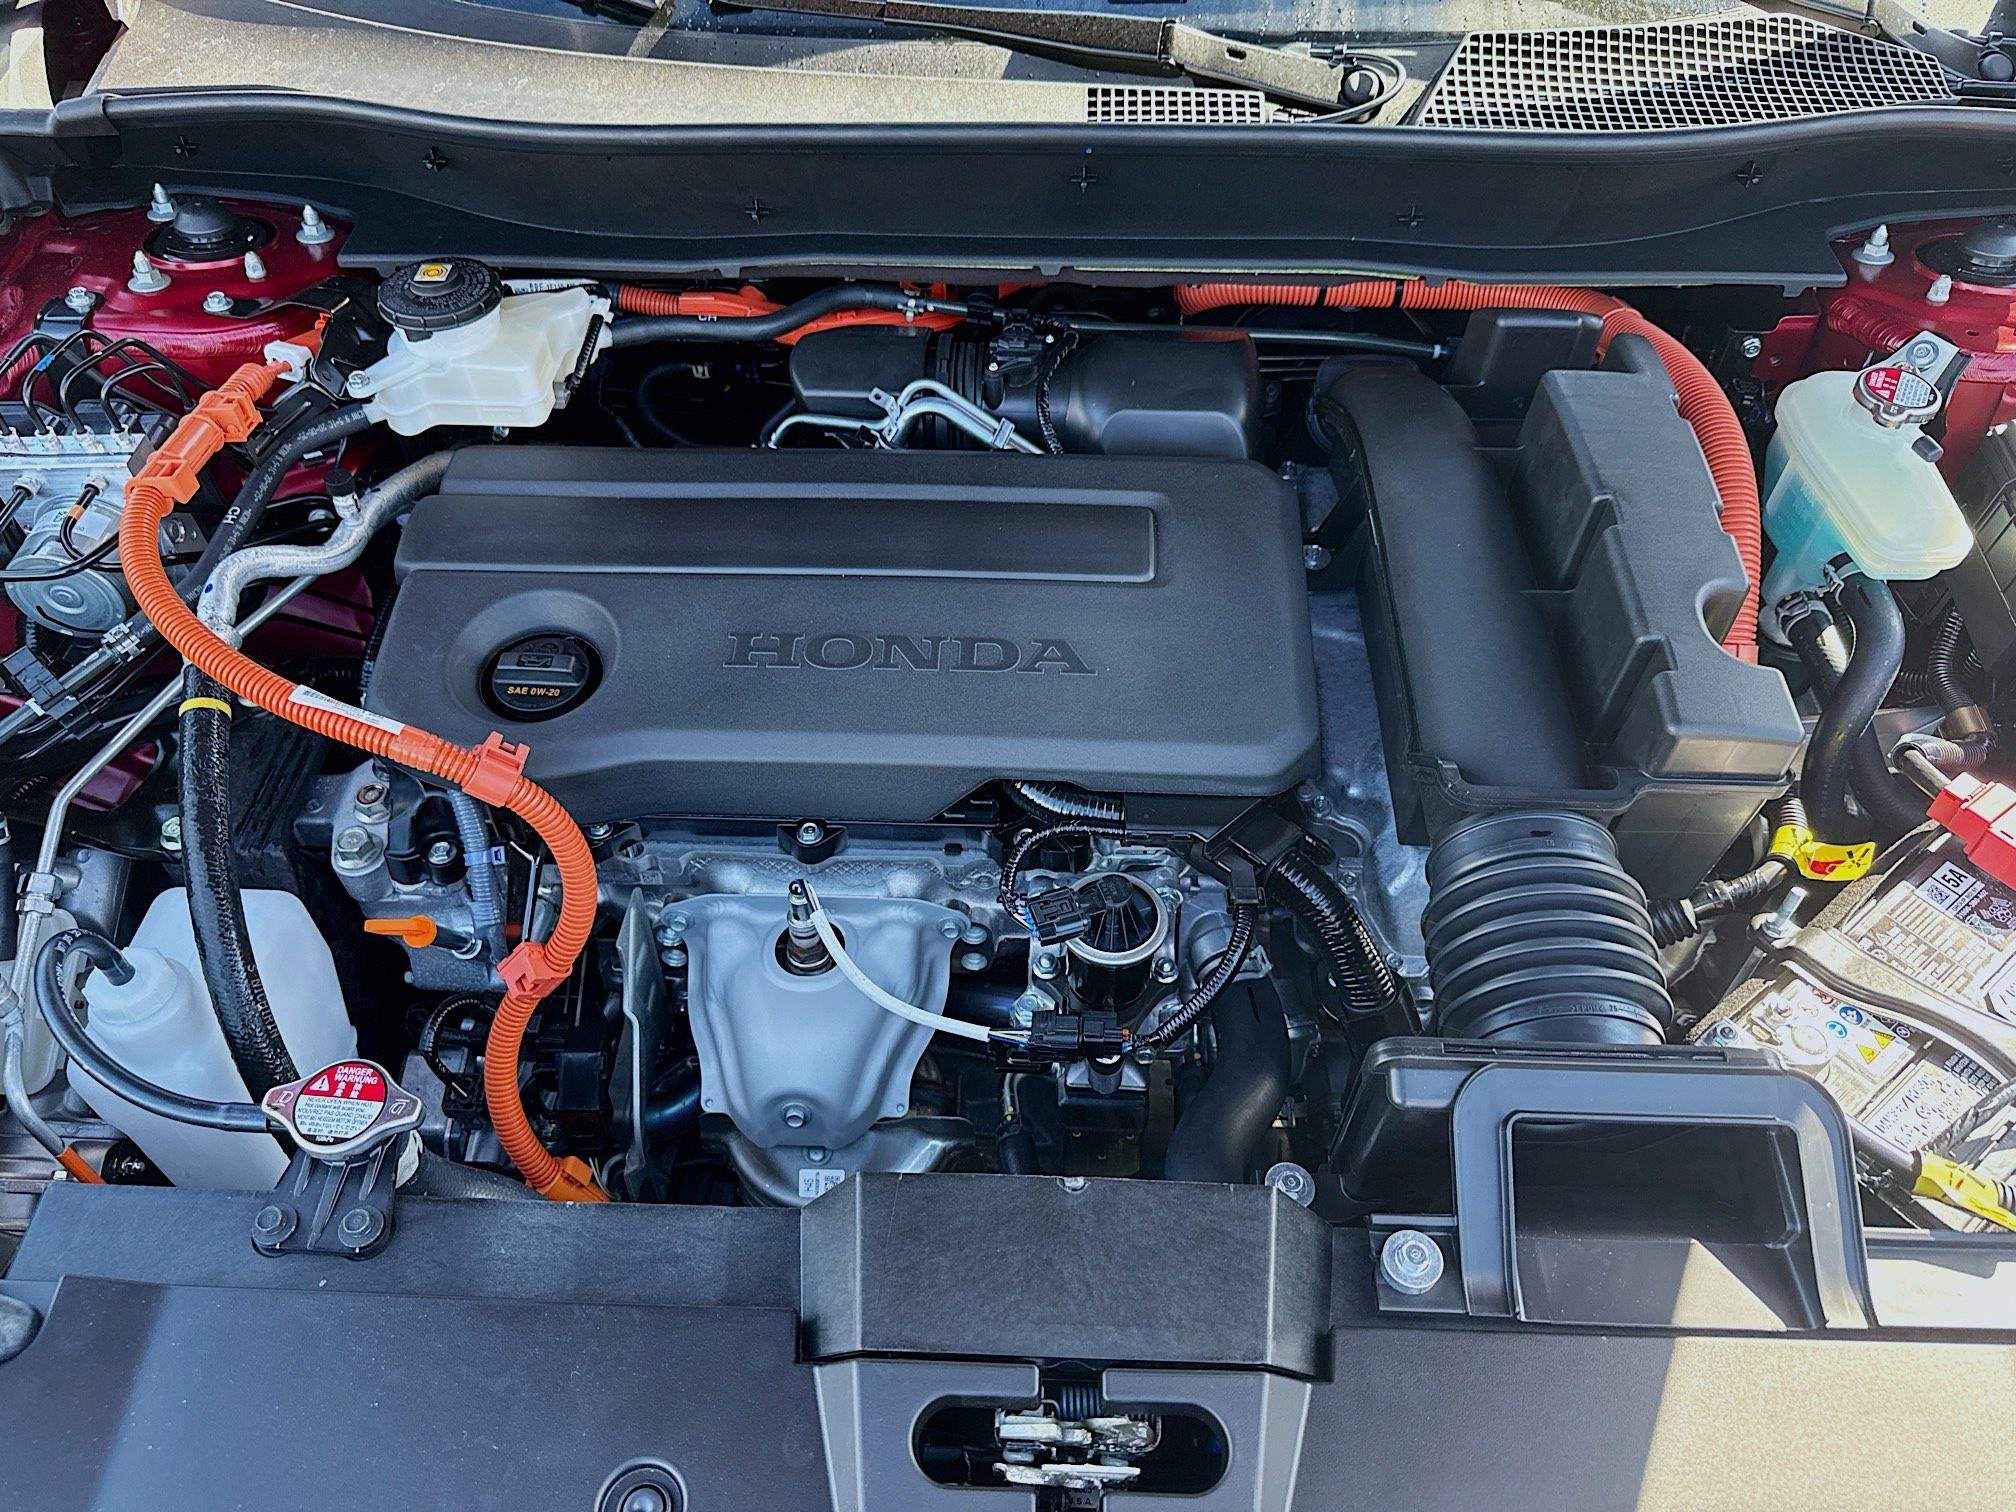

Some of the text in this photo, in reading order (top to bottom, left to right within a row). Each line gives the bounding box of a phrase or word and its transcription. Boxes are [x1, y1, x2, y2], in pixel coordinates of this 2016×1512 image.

[222, 506, 241, 525] CH
[722, 631, 1098, 676] HONDA
[507, 687, 560, 696] SAE 0W-20
[1941, 868, 1968, 888] 5A
[251, 979, 280, 1039] NICHIRIN
[334, 1073, 378, 1084] WARNUNG
[336, 1066, 373, 1076] DANGER
